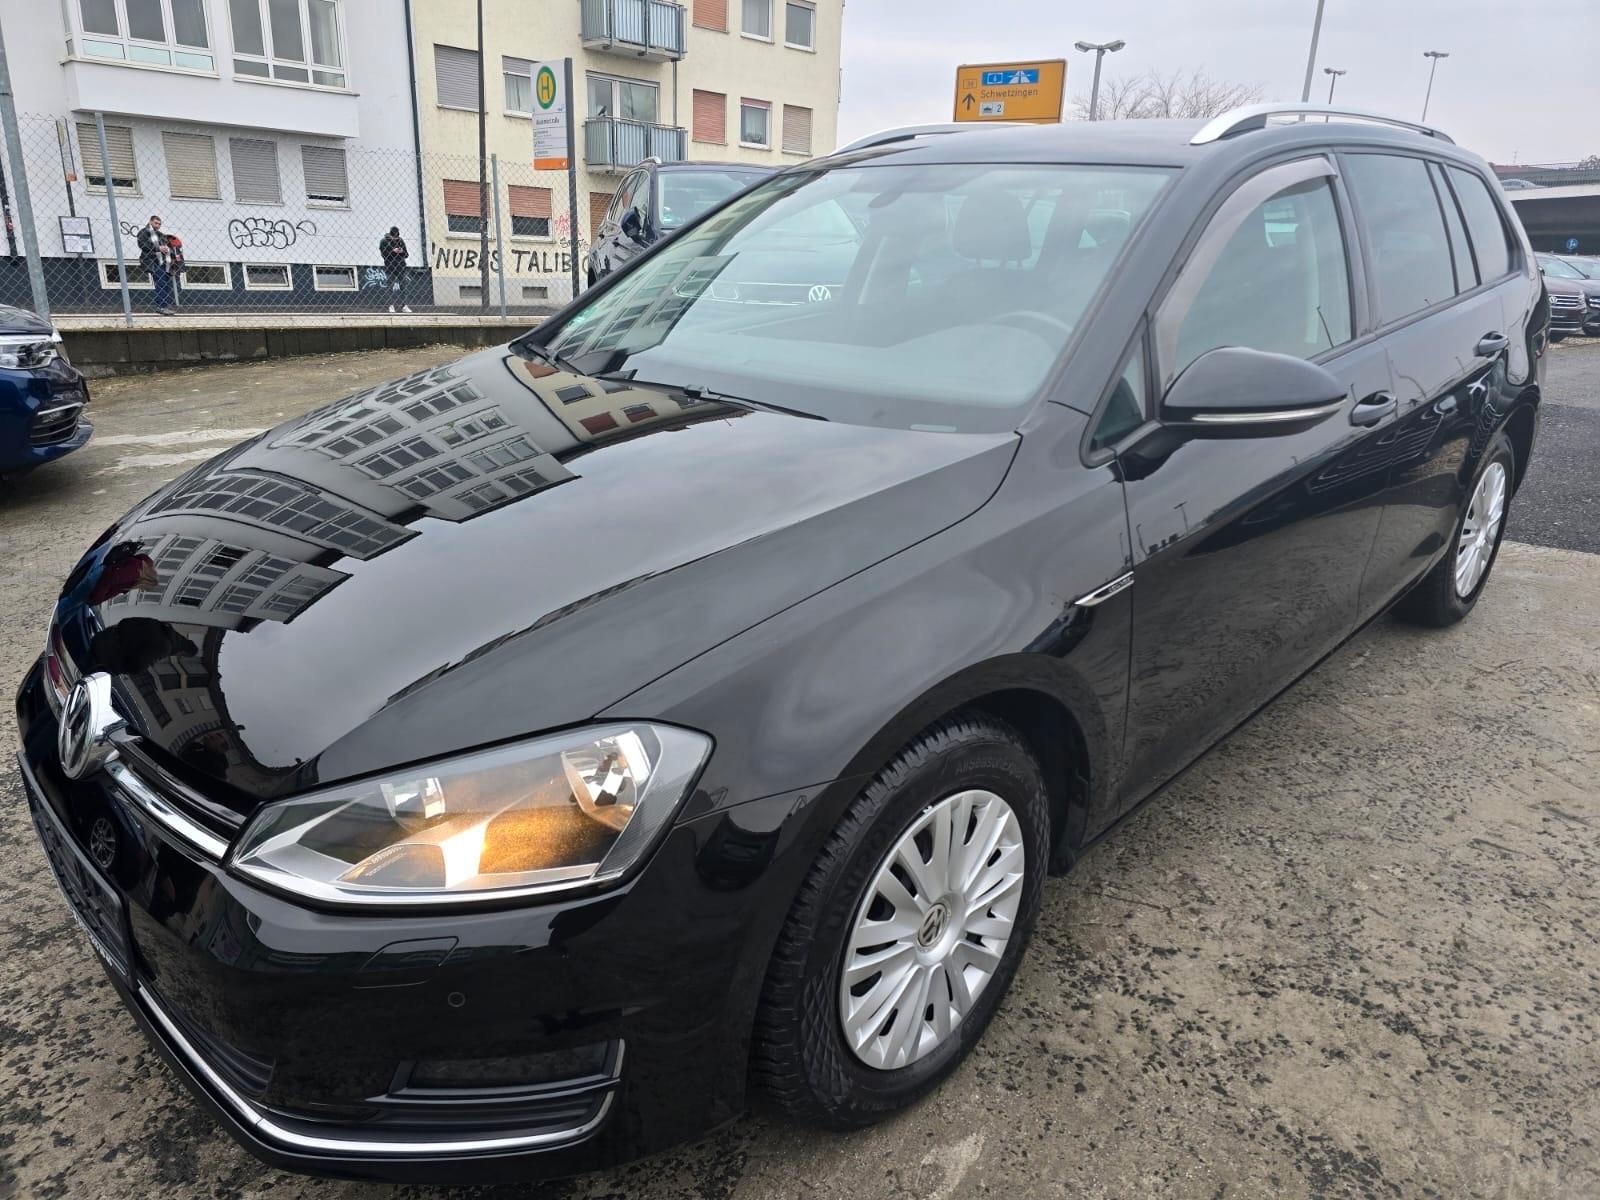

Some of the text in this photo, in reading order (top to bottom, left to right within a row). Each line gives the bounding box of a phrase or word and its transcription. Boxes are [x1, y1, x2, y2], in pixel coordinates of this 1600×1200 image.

[541, 76, 550, 100] H
[980, 88, 1038, 99] Schwetzingen
[996, 104, 1002, 113] 2
